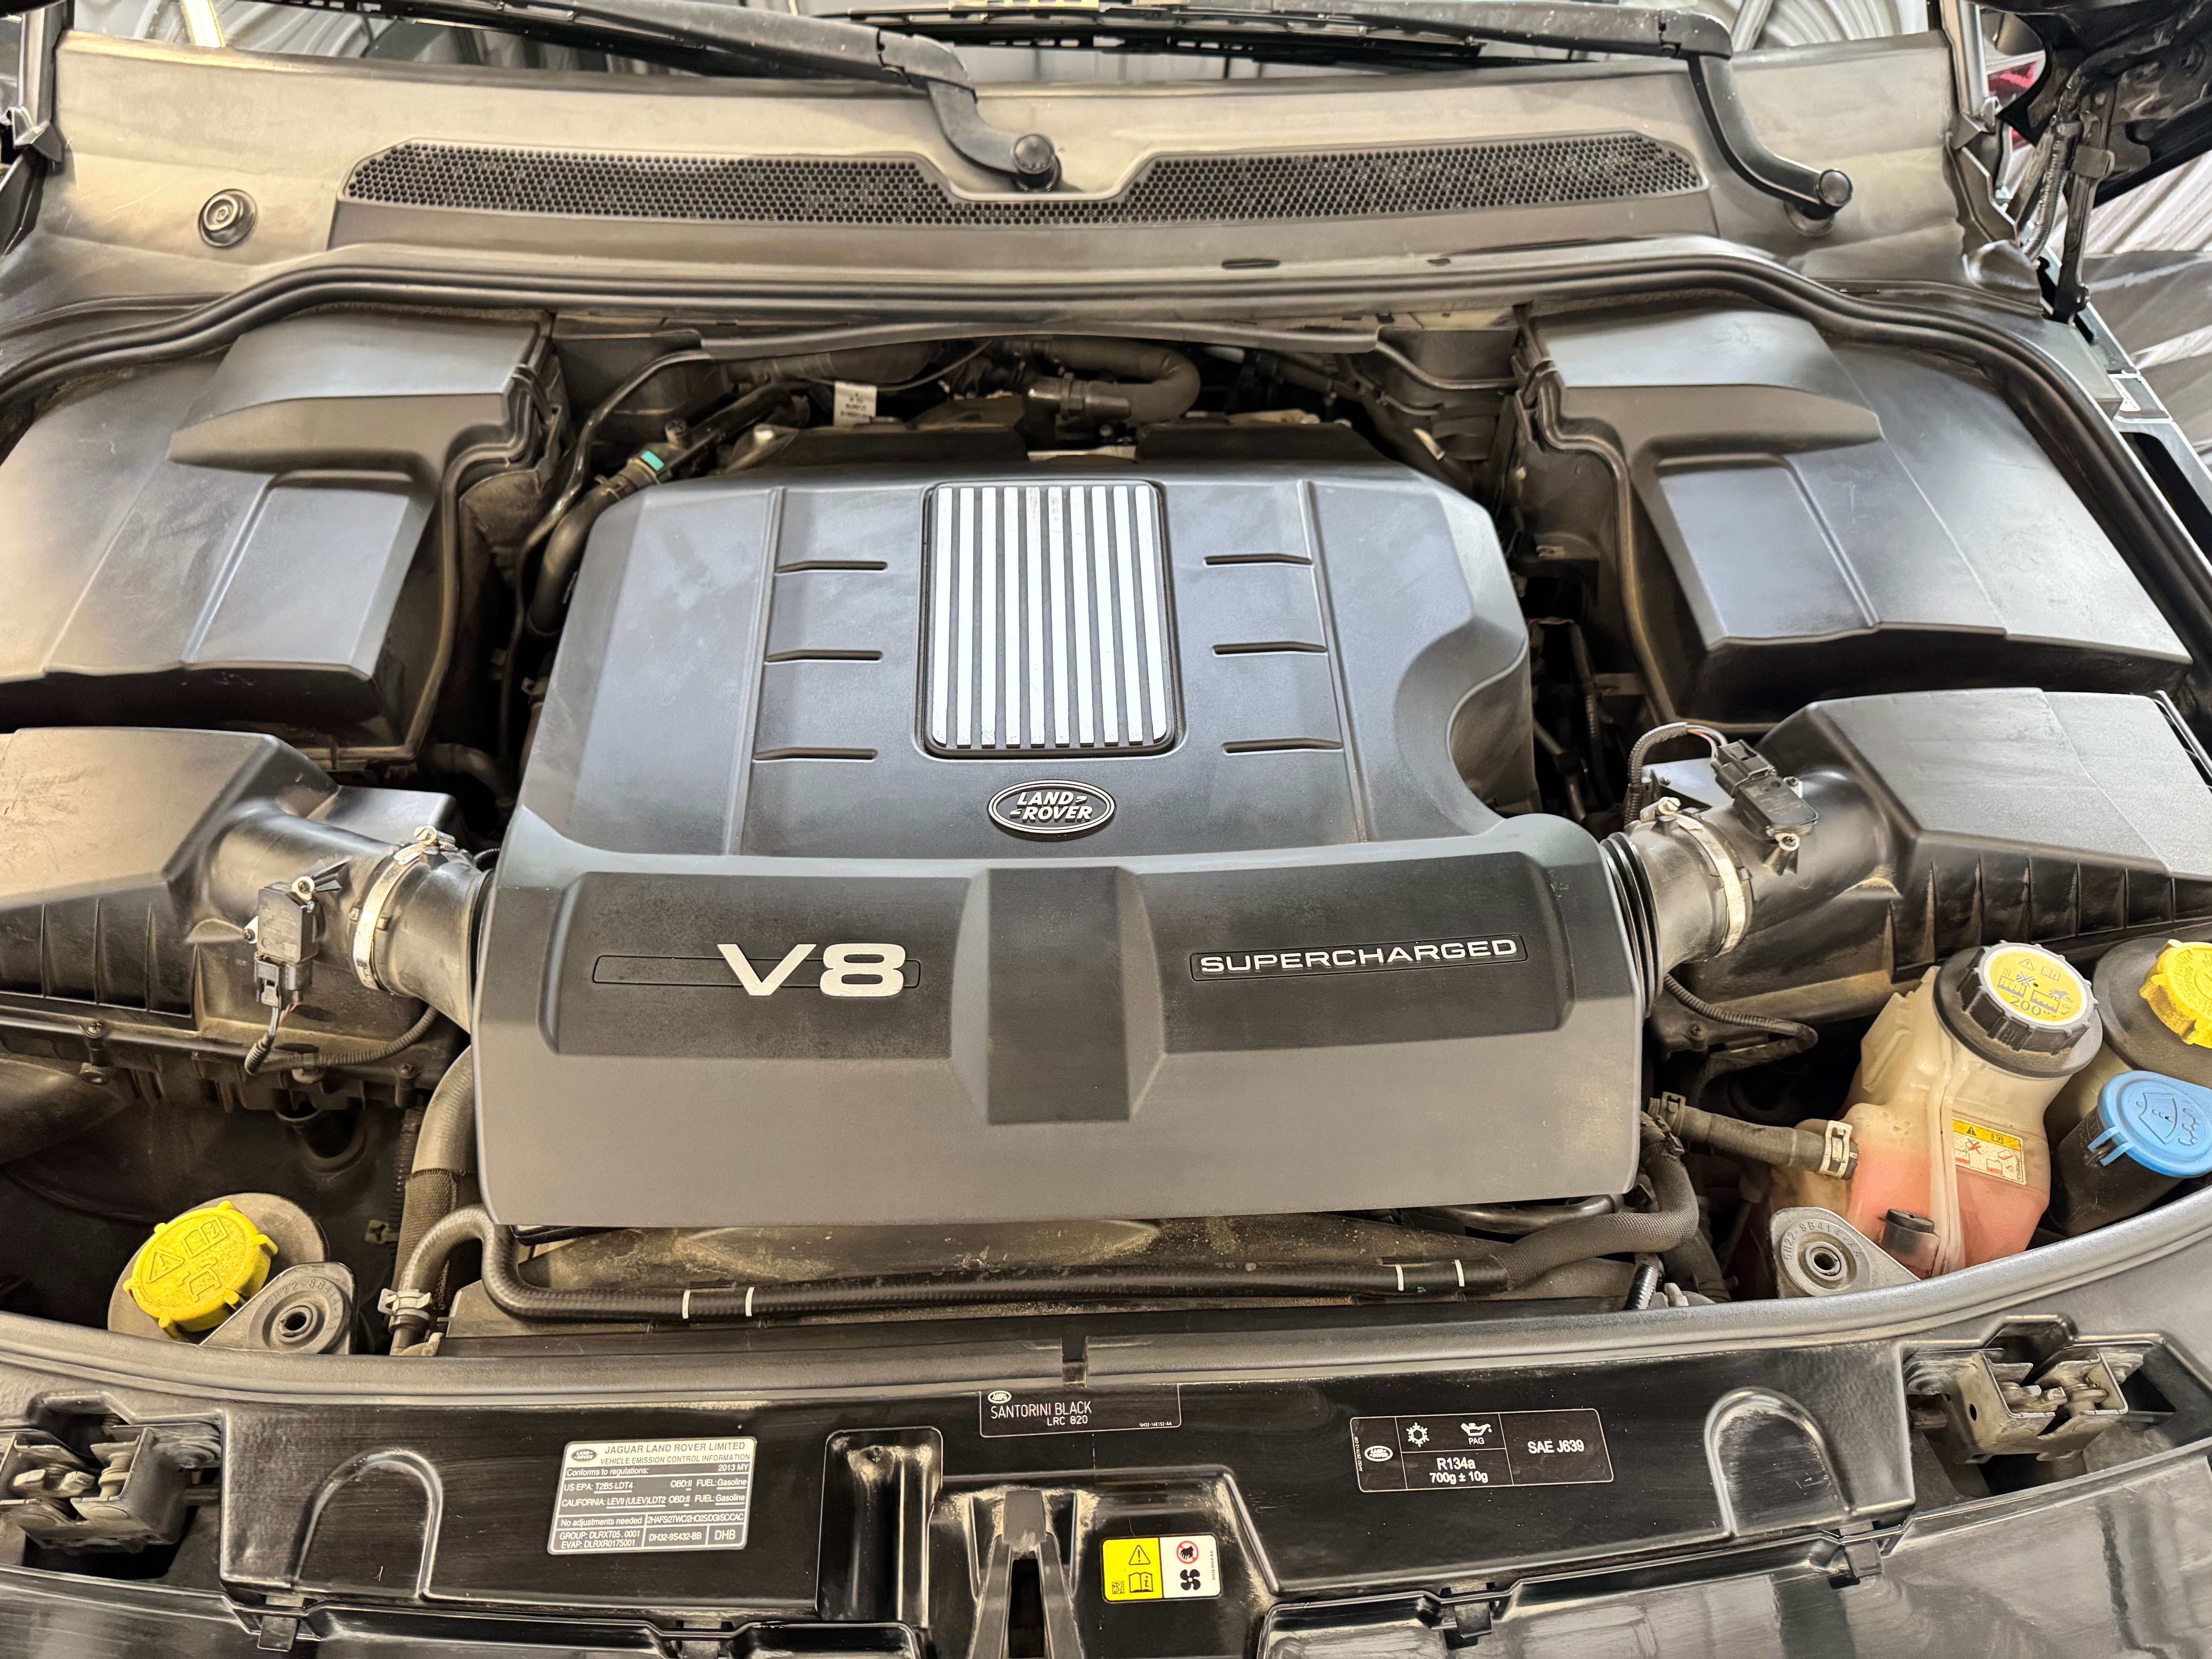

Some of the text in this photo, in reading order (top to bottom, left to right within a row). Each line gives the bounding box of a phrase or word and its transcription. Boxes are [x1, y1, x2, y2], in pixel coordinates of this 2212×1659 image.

[1200, 939, 1518, 974] SUPERCHARGED
[717, 943, 906, 998] V8
[2009, 995, 2042, 1016] 200
[991, 1401, 1092, 1419] SANTORINI BLACK
[1047, 1415, 1088, 1426] LRC 820
[605, 1445, 643, 1454] JAGUAR
[674, 1443, 706, 1452] ROVER
[709, 1442, 745, 1451] LIMITED
[1527, 1439, 1584, 1454] SAE J639
[702, 1453, 750, 1462] INFORMATION
[1437, 1457, 1476, 1470] R134a
[567, 1468, 600, 1476] Conforms
[609, 1467, 649, 1476] regulations:
[717, 1478, 747, 1486] Gasoline
[1430, 1473, 1457, 1485] 700g
[1468, 1471, 1489, 1483] 10g
[595, 1482, 614, 1490] T2B5
[614, 1482, 634, 1490] LDT4
[562, 1498, 606, 1507] CALIFORNIA:
[715, 1493, 745, 1502] Gasoline
[572, 1518, 615, 1527] adjustments
[616, 1516, 643, 1525] needed
[559, 1531, 588, 1540] GROUP:
[714, 1529, 736, 1540] DHB
[561, 1541, 582, 1549] EVAP:
